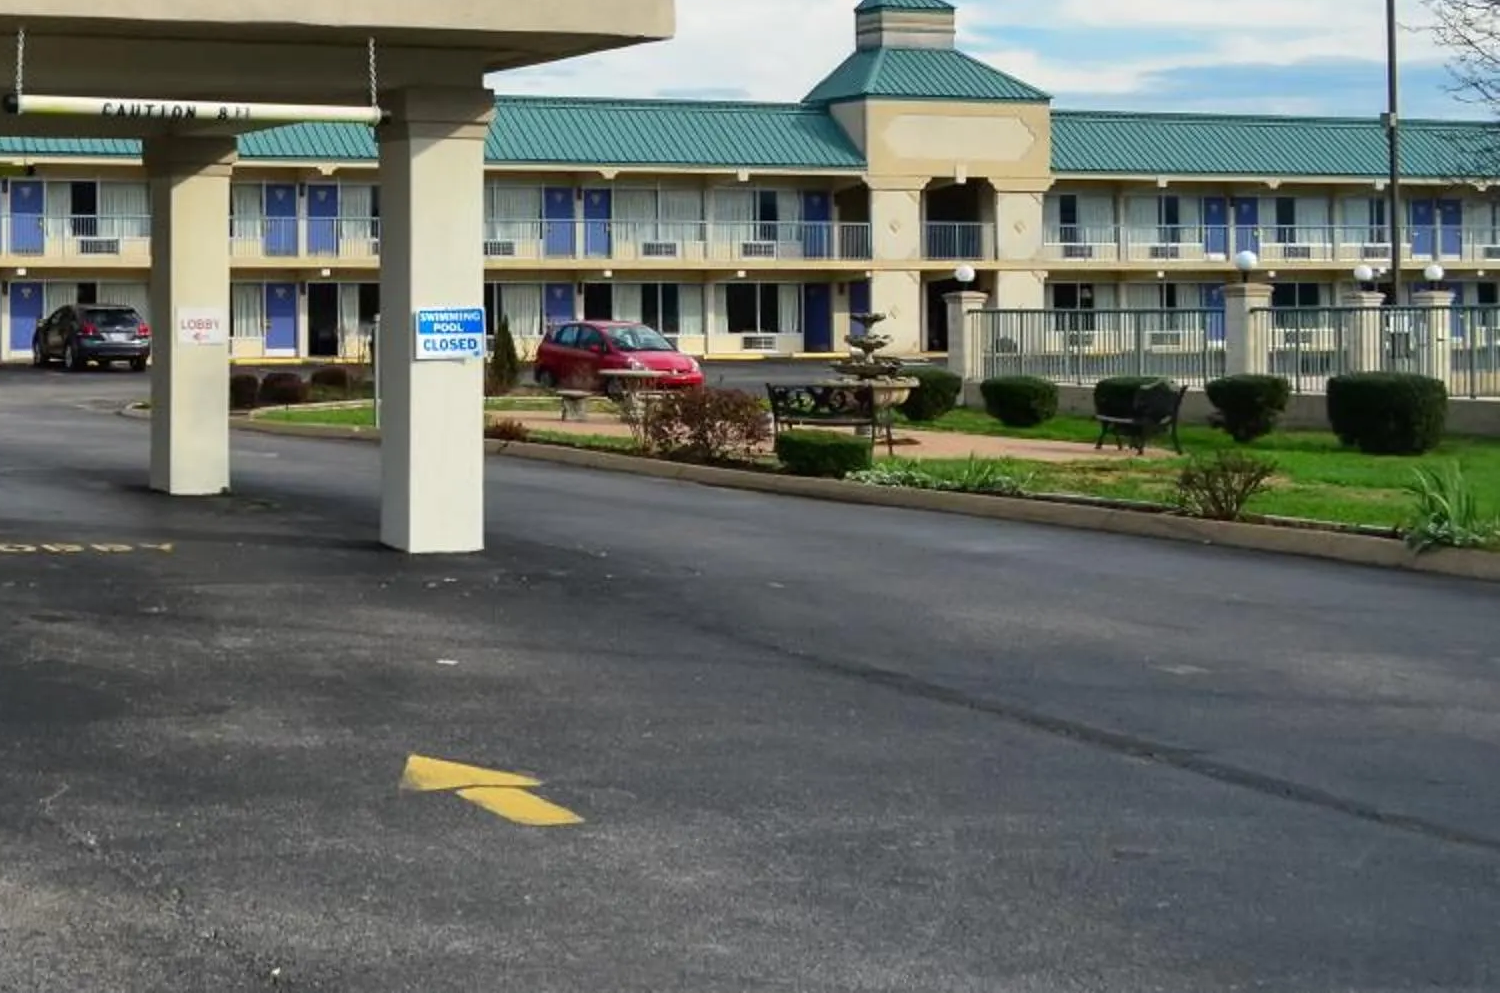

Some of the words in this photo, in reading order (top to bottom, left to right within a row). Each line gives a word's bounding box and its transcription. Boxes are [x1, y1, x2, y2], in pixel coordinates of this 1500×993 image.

[100, 102, 197, 119] CAUTION
[419, 310, 481, 322] SWIMMING
[180, 317, 220, 331] LOBBY
[433, 322, 465, 333] POOL
[423, 338, 477, 352] CLOSED
